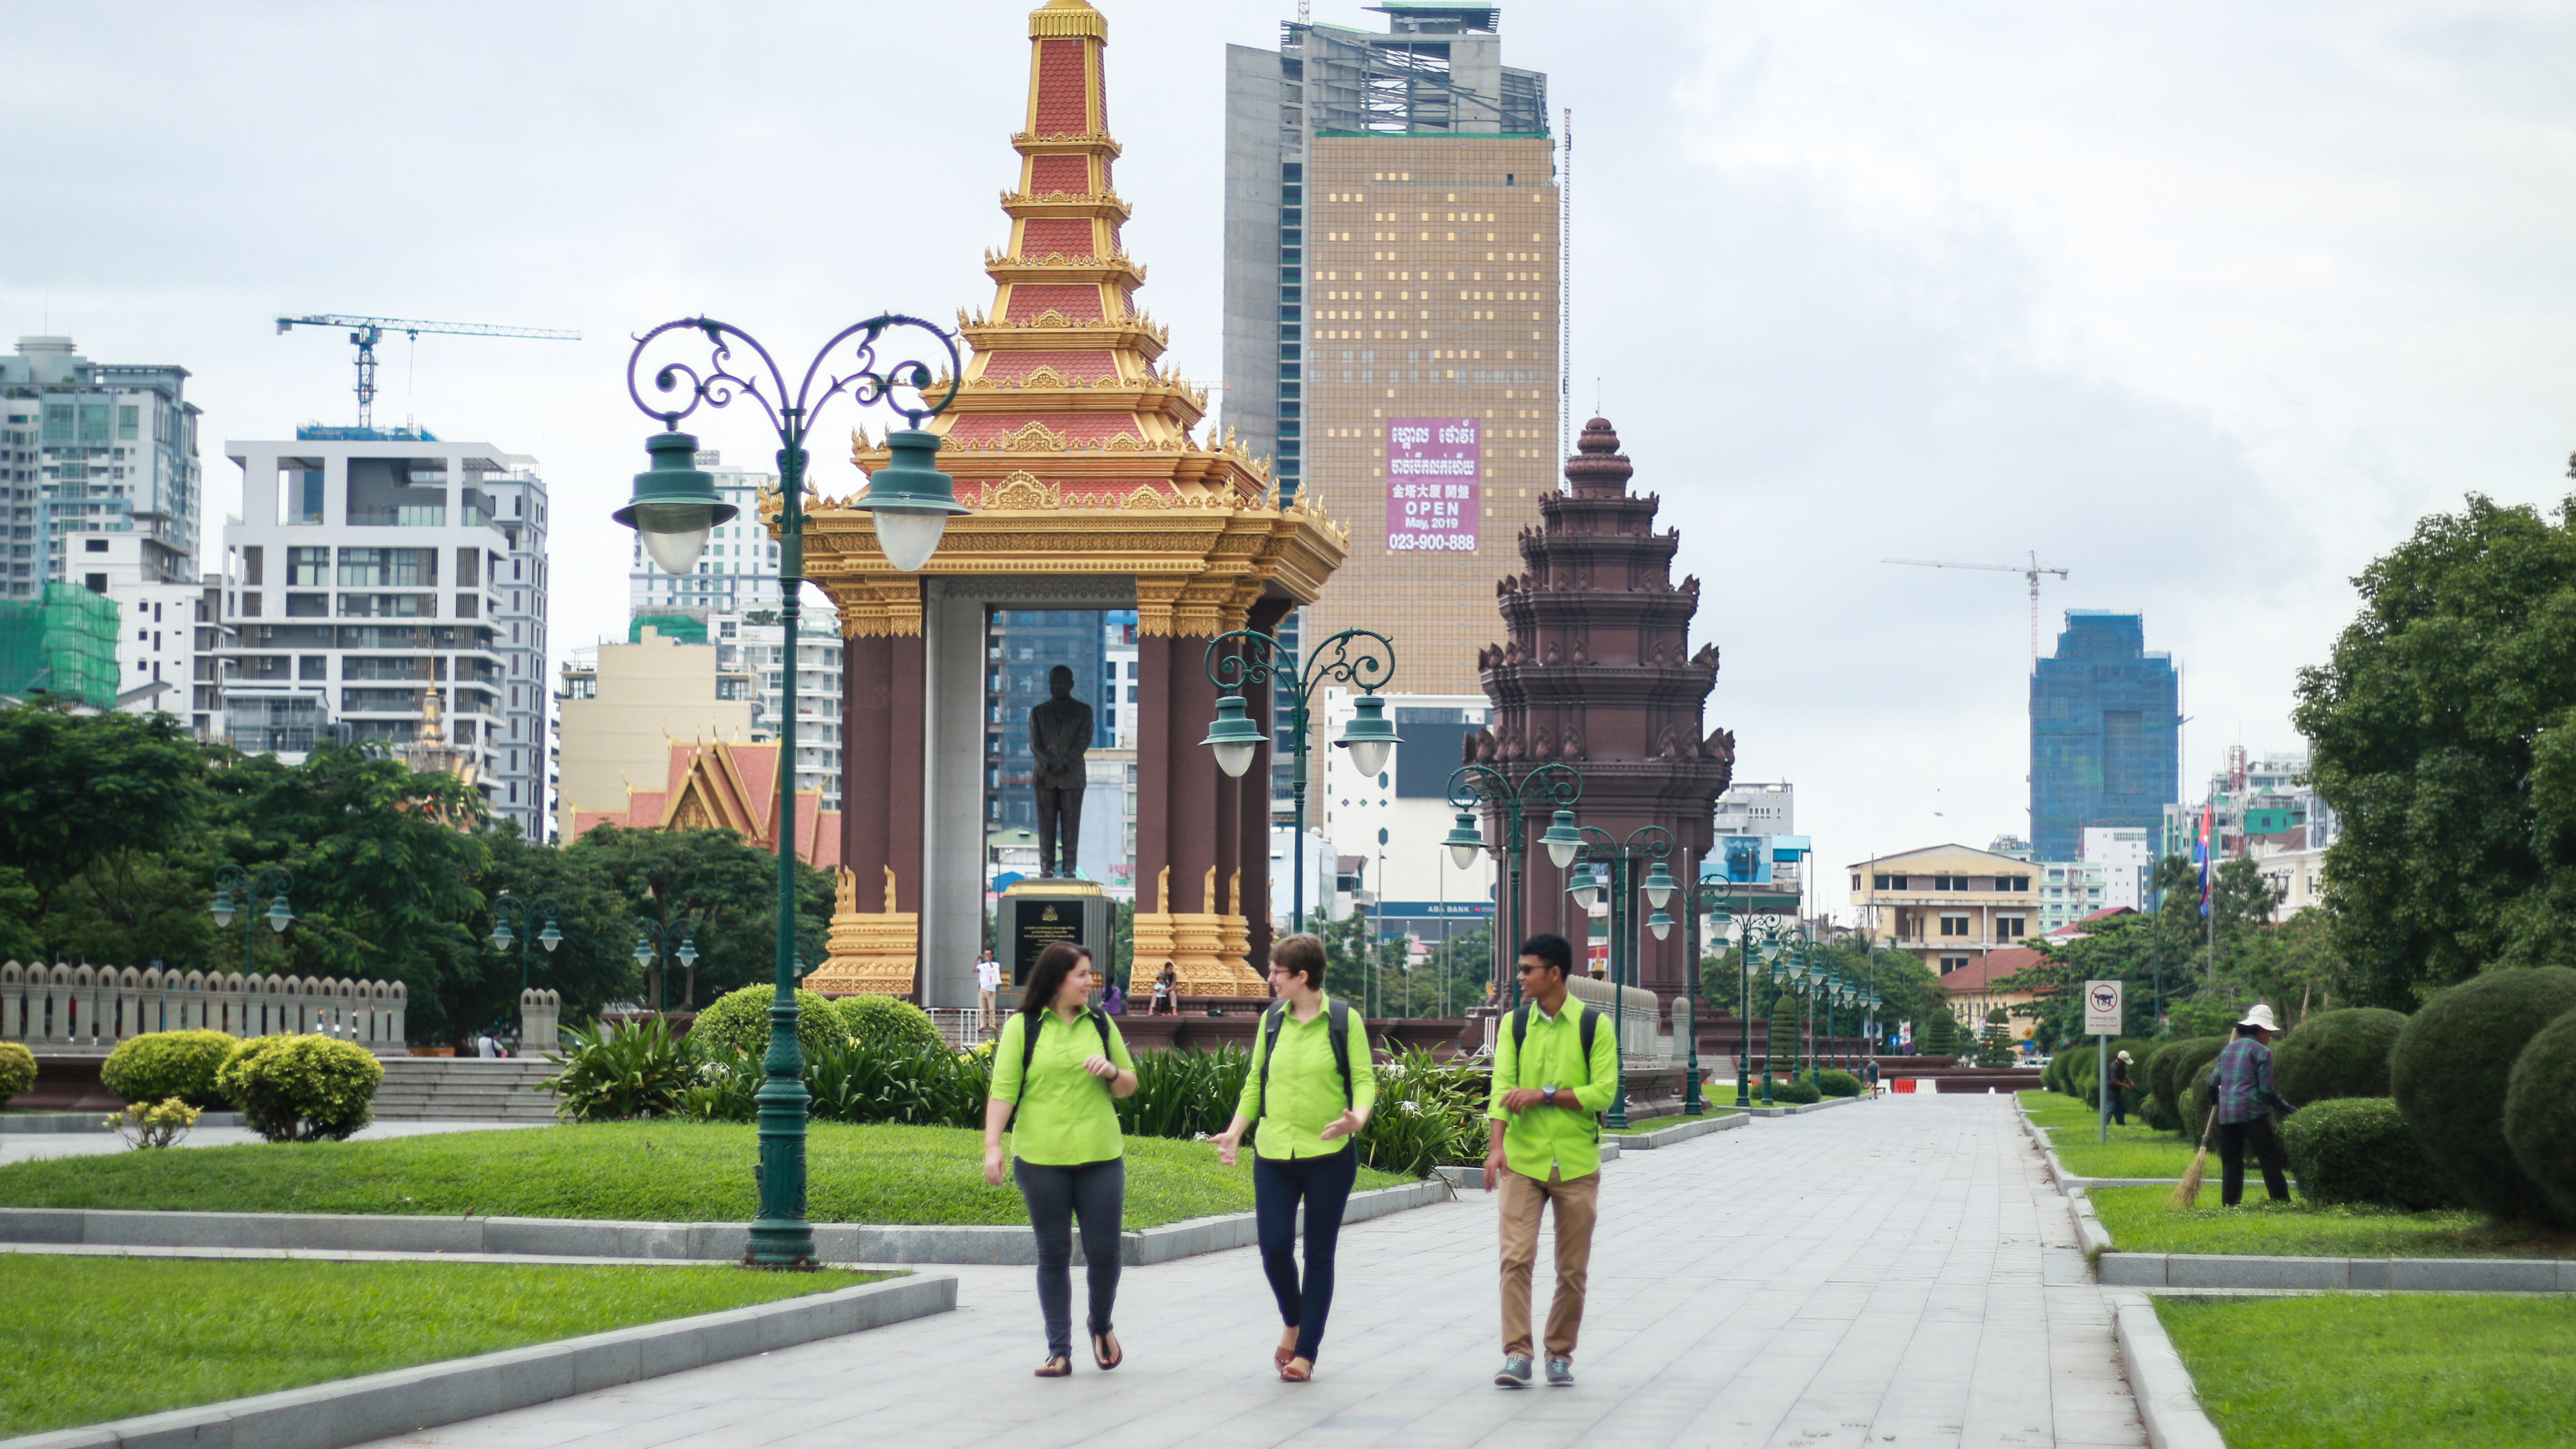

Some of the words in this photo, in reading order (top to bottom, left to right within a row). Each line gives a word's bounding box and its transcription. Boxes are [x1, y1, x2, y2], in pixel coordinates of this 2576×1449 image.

[1405, 501, 1459, 515] OPEN
[1405, 517, 1429, 530] May,
[1431, 518, 1459, 529] 2019
[1389, 534, 1474, 551] 023-900-888
